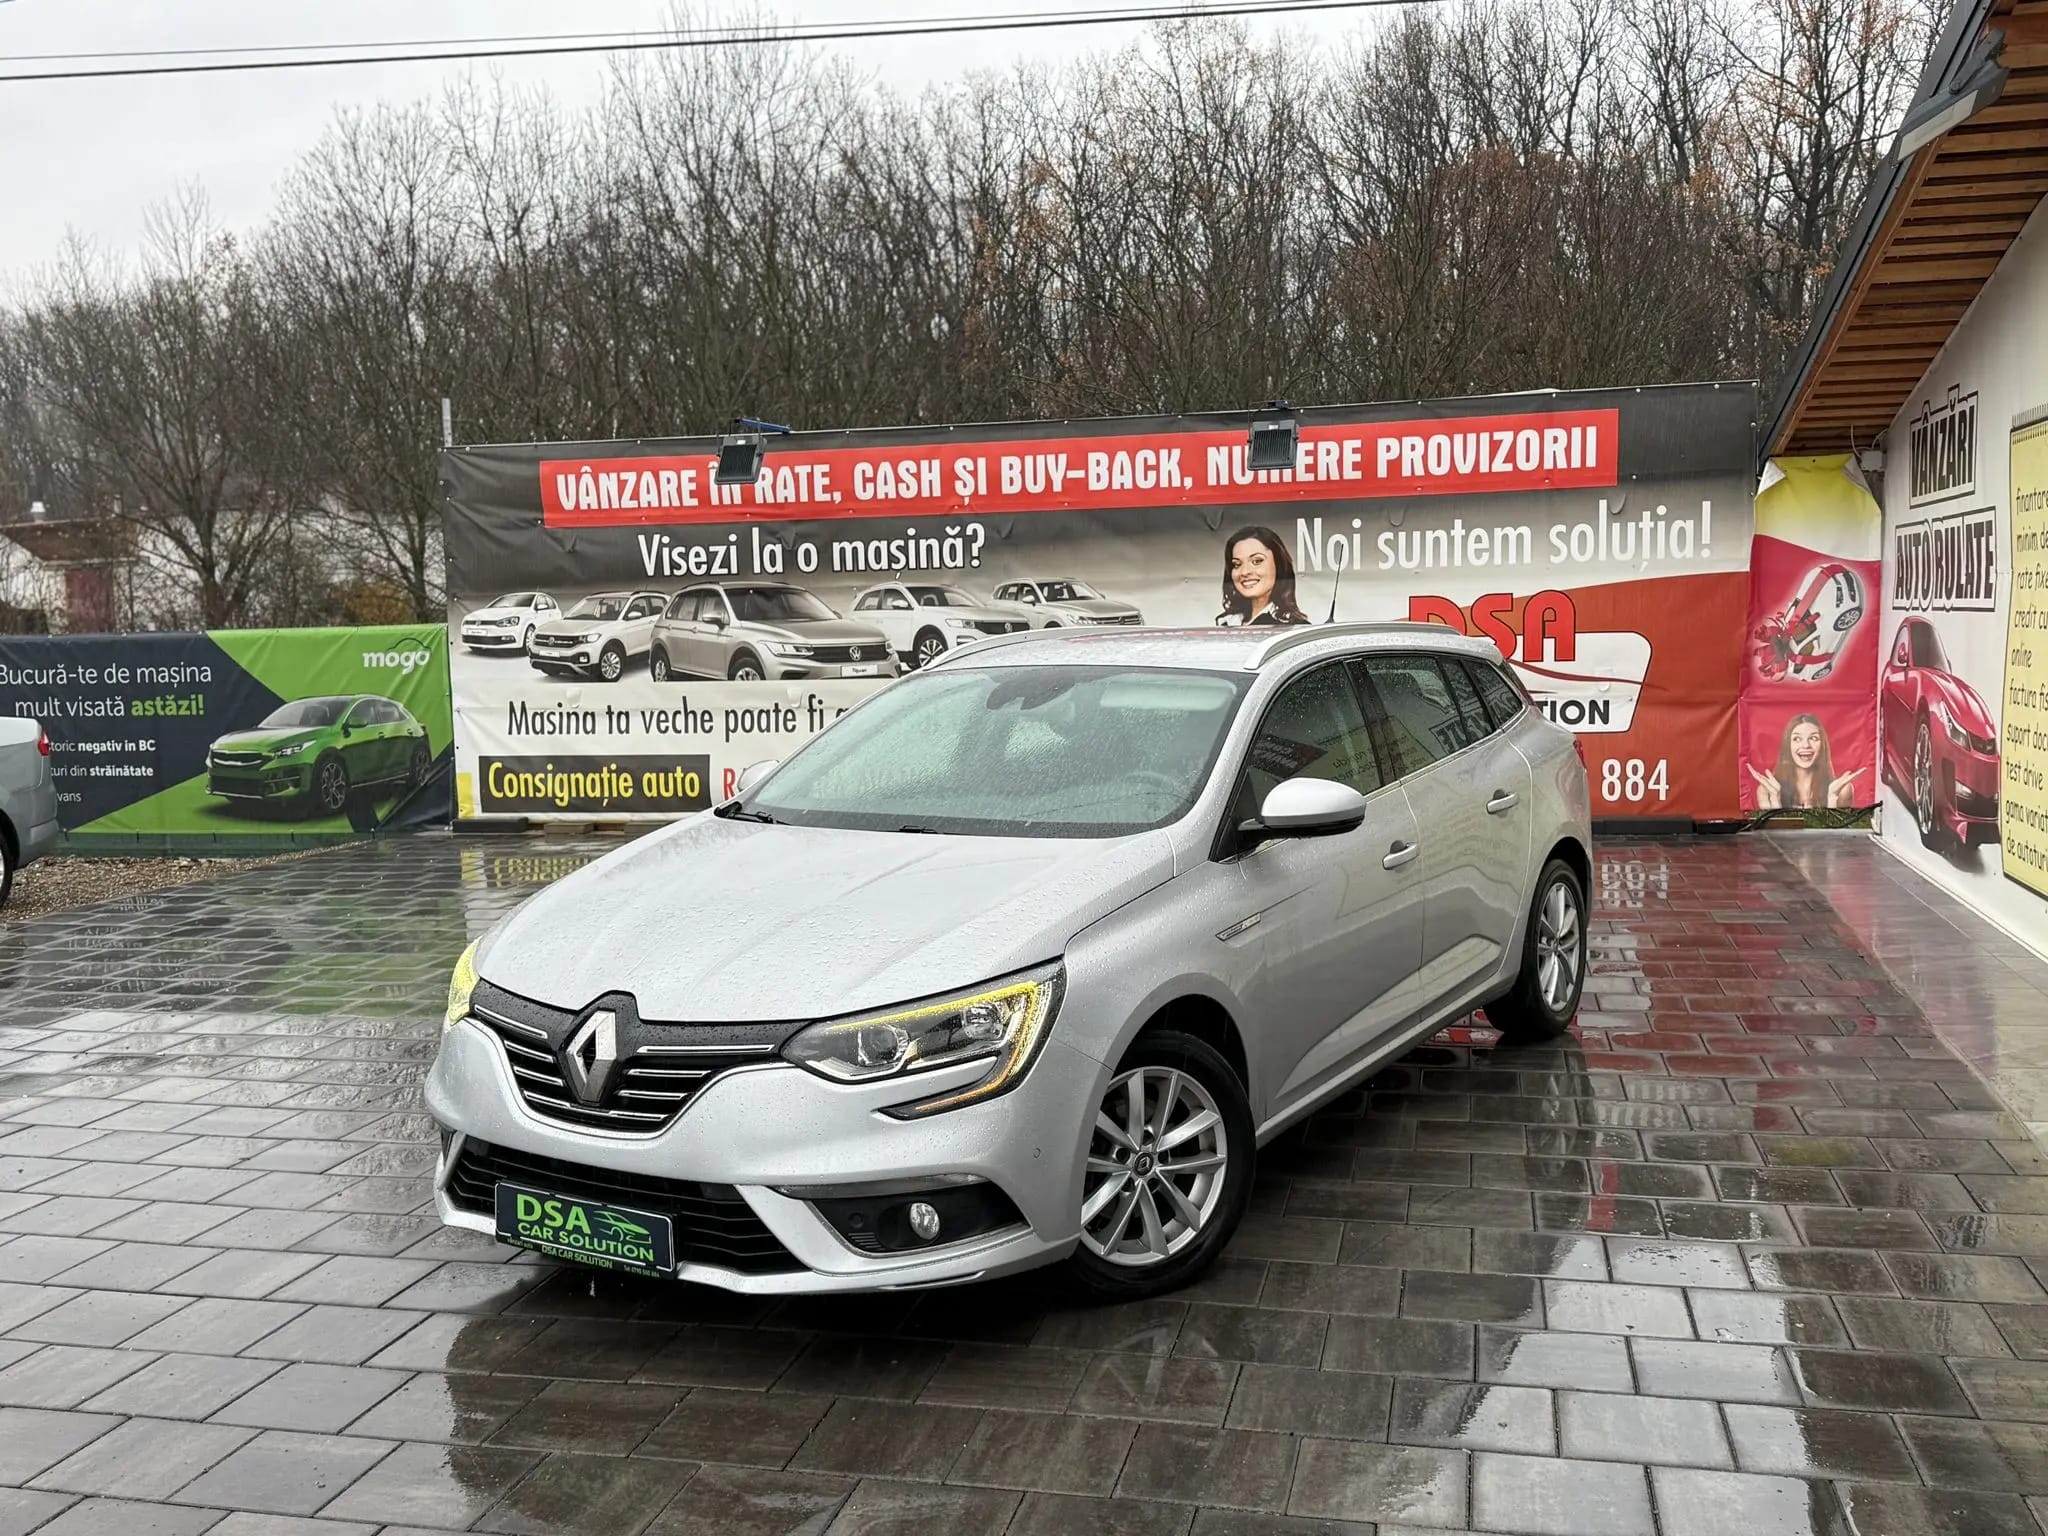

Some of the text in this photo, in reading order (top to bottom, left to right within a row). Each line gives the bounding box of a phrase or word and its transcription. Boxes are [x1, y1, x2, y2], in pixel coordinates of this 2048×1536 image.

[1911, 397, 1976, 498] VÂNZĂRI
[556, 465, 699, 511] VÂNZARE
[754, 464, 842, 504] RATE,
[853, 459, 942, 501] CASH
[954, 457, 987, 506] ȘI
[1001, 448, 1194, 495] BUY-BACK,
[1376, 426, 1598, 479] PROVIZORII
[637, 522, 986, 579] Visezi la o mașină?
[1295, 498, 1712, 573] Noi suntem soluția!
[2016, 567, 2032, 590] rate
[2015, 602, 2036, 629] credit
[0, 662, 212, 688] Bucură-te de mașina
[362, 651, 430, 675] mogo
[15, 694, 205, 717] mult visată astăzi!
[507, 693, 824, 743] Masina ta veche poate fi
[49, 740, 76, 752] toric
[78, 740, 122, 754] negativ
[138, 740, 156, 751] BC
[2033, 721, 2048, 751] doc
[69, 765, 87, 776] din
[89, 764, 154, 777] străinătate
[488, 761, 633, 808] Consignație
[642, 764, 700, 799] auto
[1601, 758, 1670, 802] 884
[2006, 756, 2043, 790] test drive
[56, 792, 82, 802] vans
[2007, 829, 2016, 856] de
[516, 1193, 592, 1235] DSA
[517, 1222, 554, 1240] CAR
[559, 1231, 654, 1262] SOLUTION
[541, 1244, 613, 1269] DSA CAR SOLUTION
